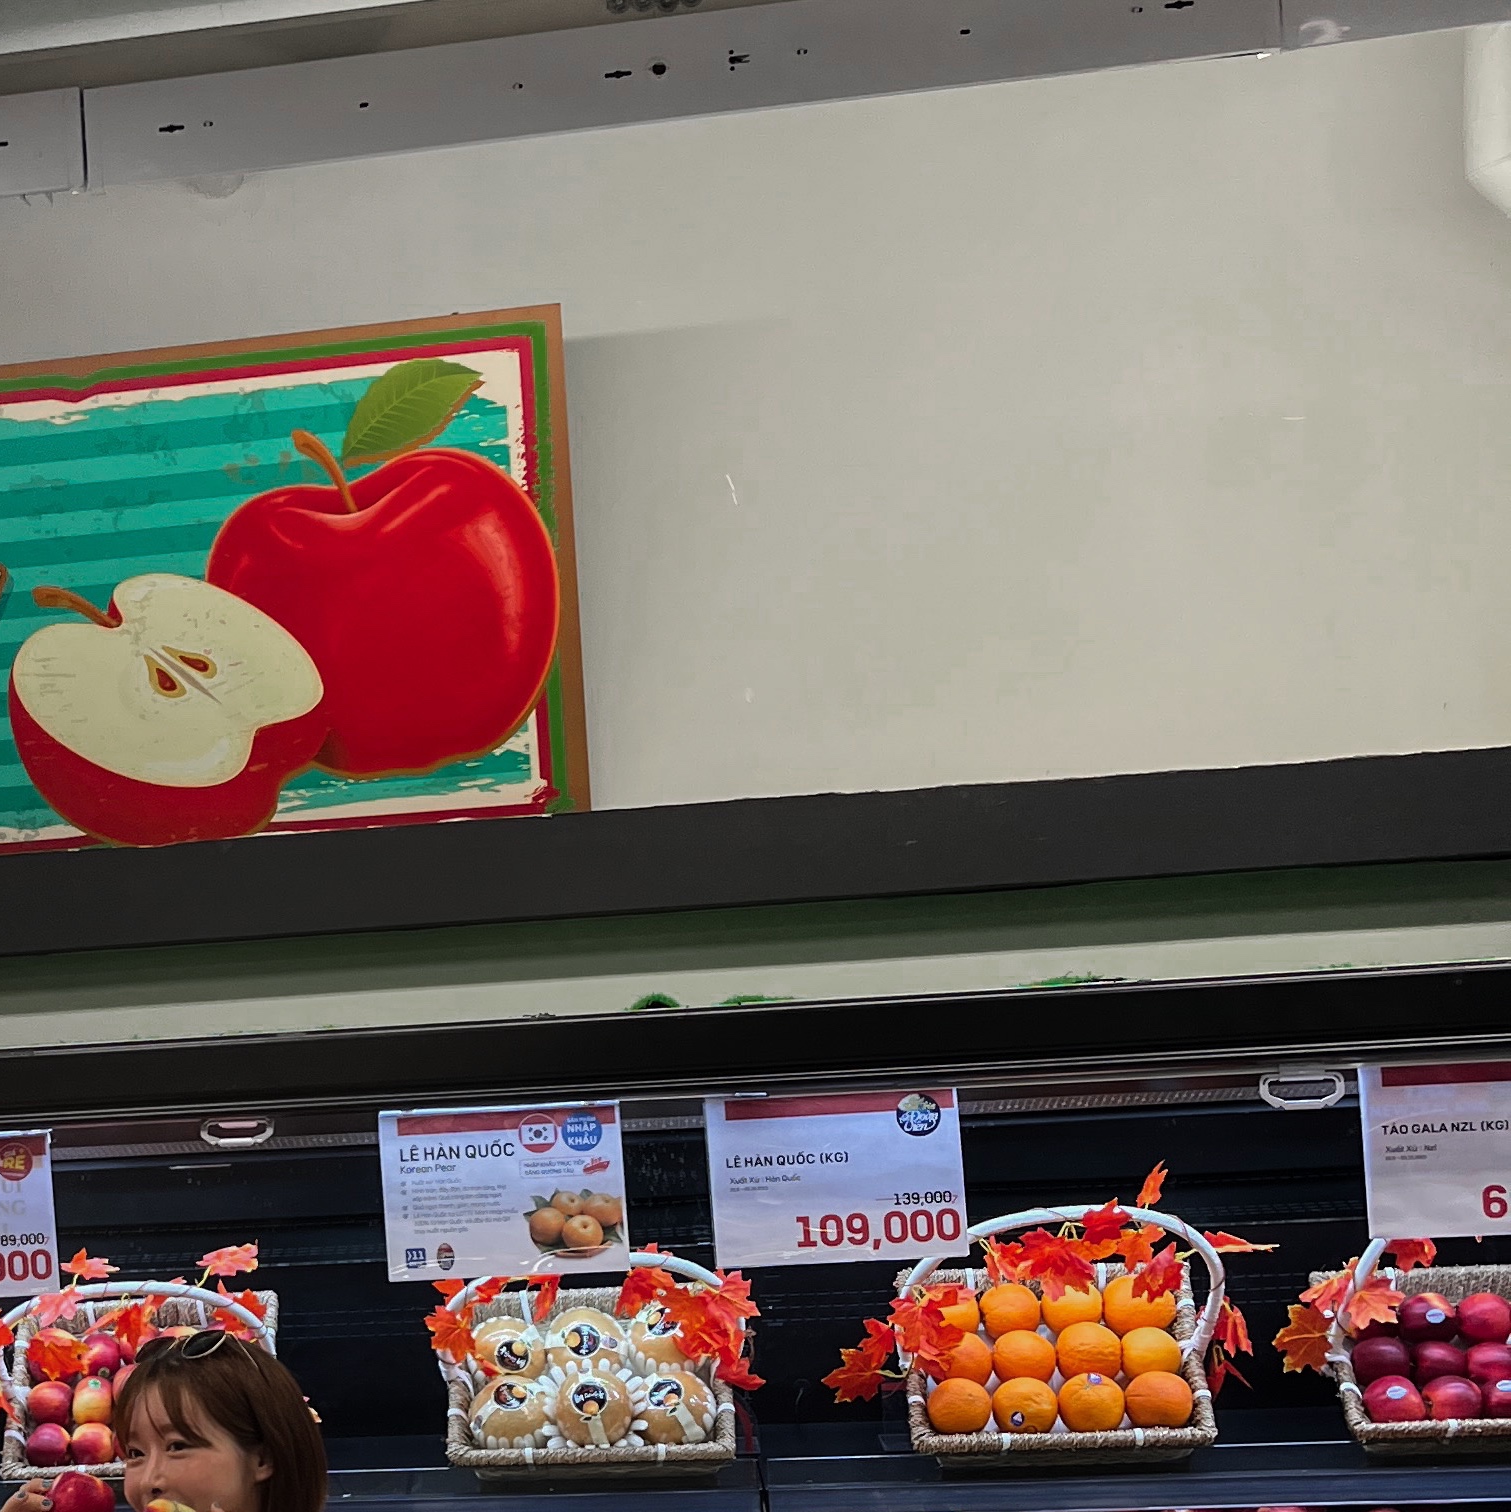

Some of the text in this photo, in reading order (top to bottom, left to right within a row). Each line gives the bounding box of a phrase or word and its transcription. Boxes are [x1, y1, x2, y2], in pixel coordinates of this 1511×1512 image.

[566, 1121, 597, 1133] NHẬP
[1381, 1119, 1509, 1135] TÁO GALA NZL (KG)
[567, 1134, 598, 1146] KHẨU
[399, 1138, 515, 1162] LÊ HÀN QUỐC
[725, 1151, 849, 1168] LÊ HÀN QUỐC (KG)
[399, 1163, 457, 1175] Korean Pear
[893, 1190, 952, 1206] 139,000
[795, 1208, 961, 1250] 109,000
[0, 1232, 45, 1248] 89,000
